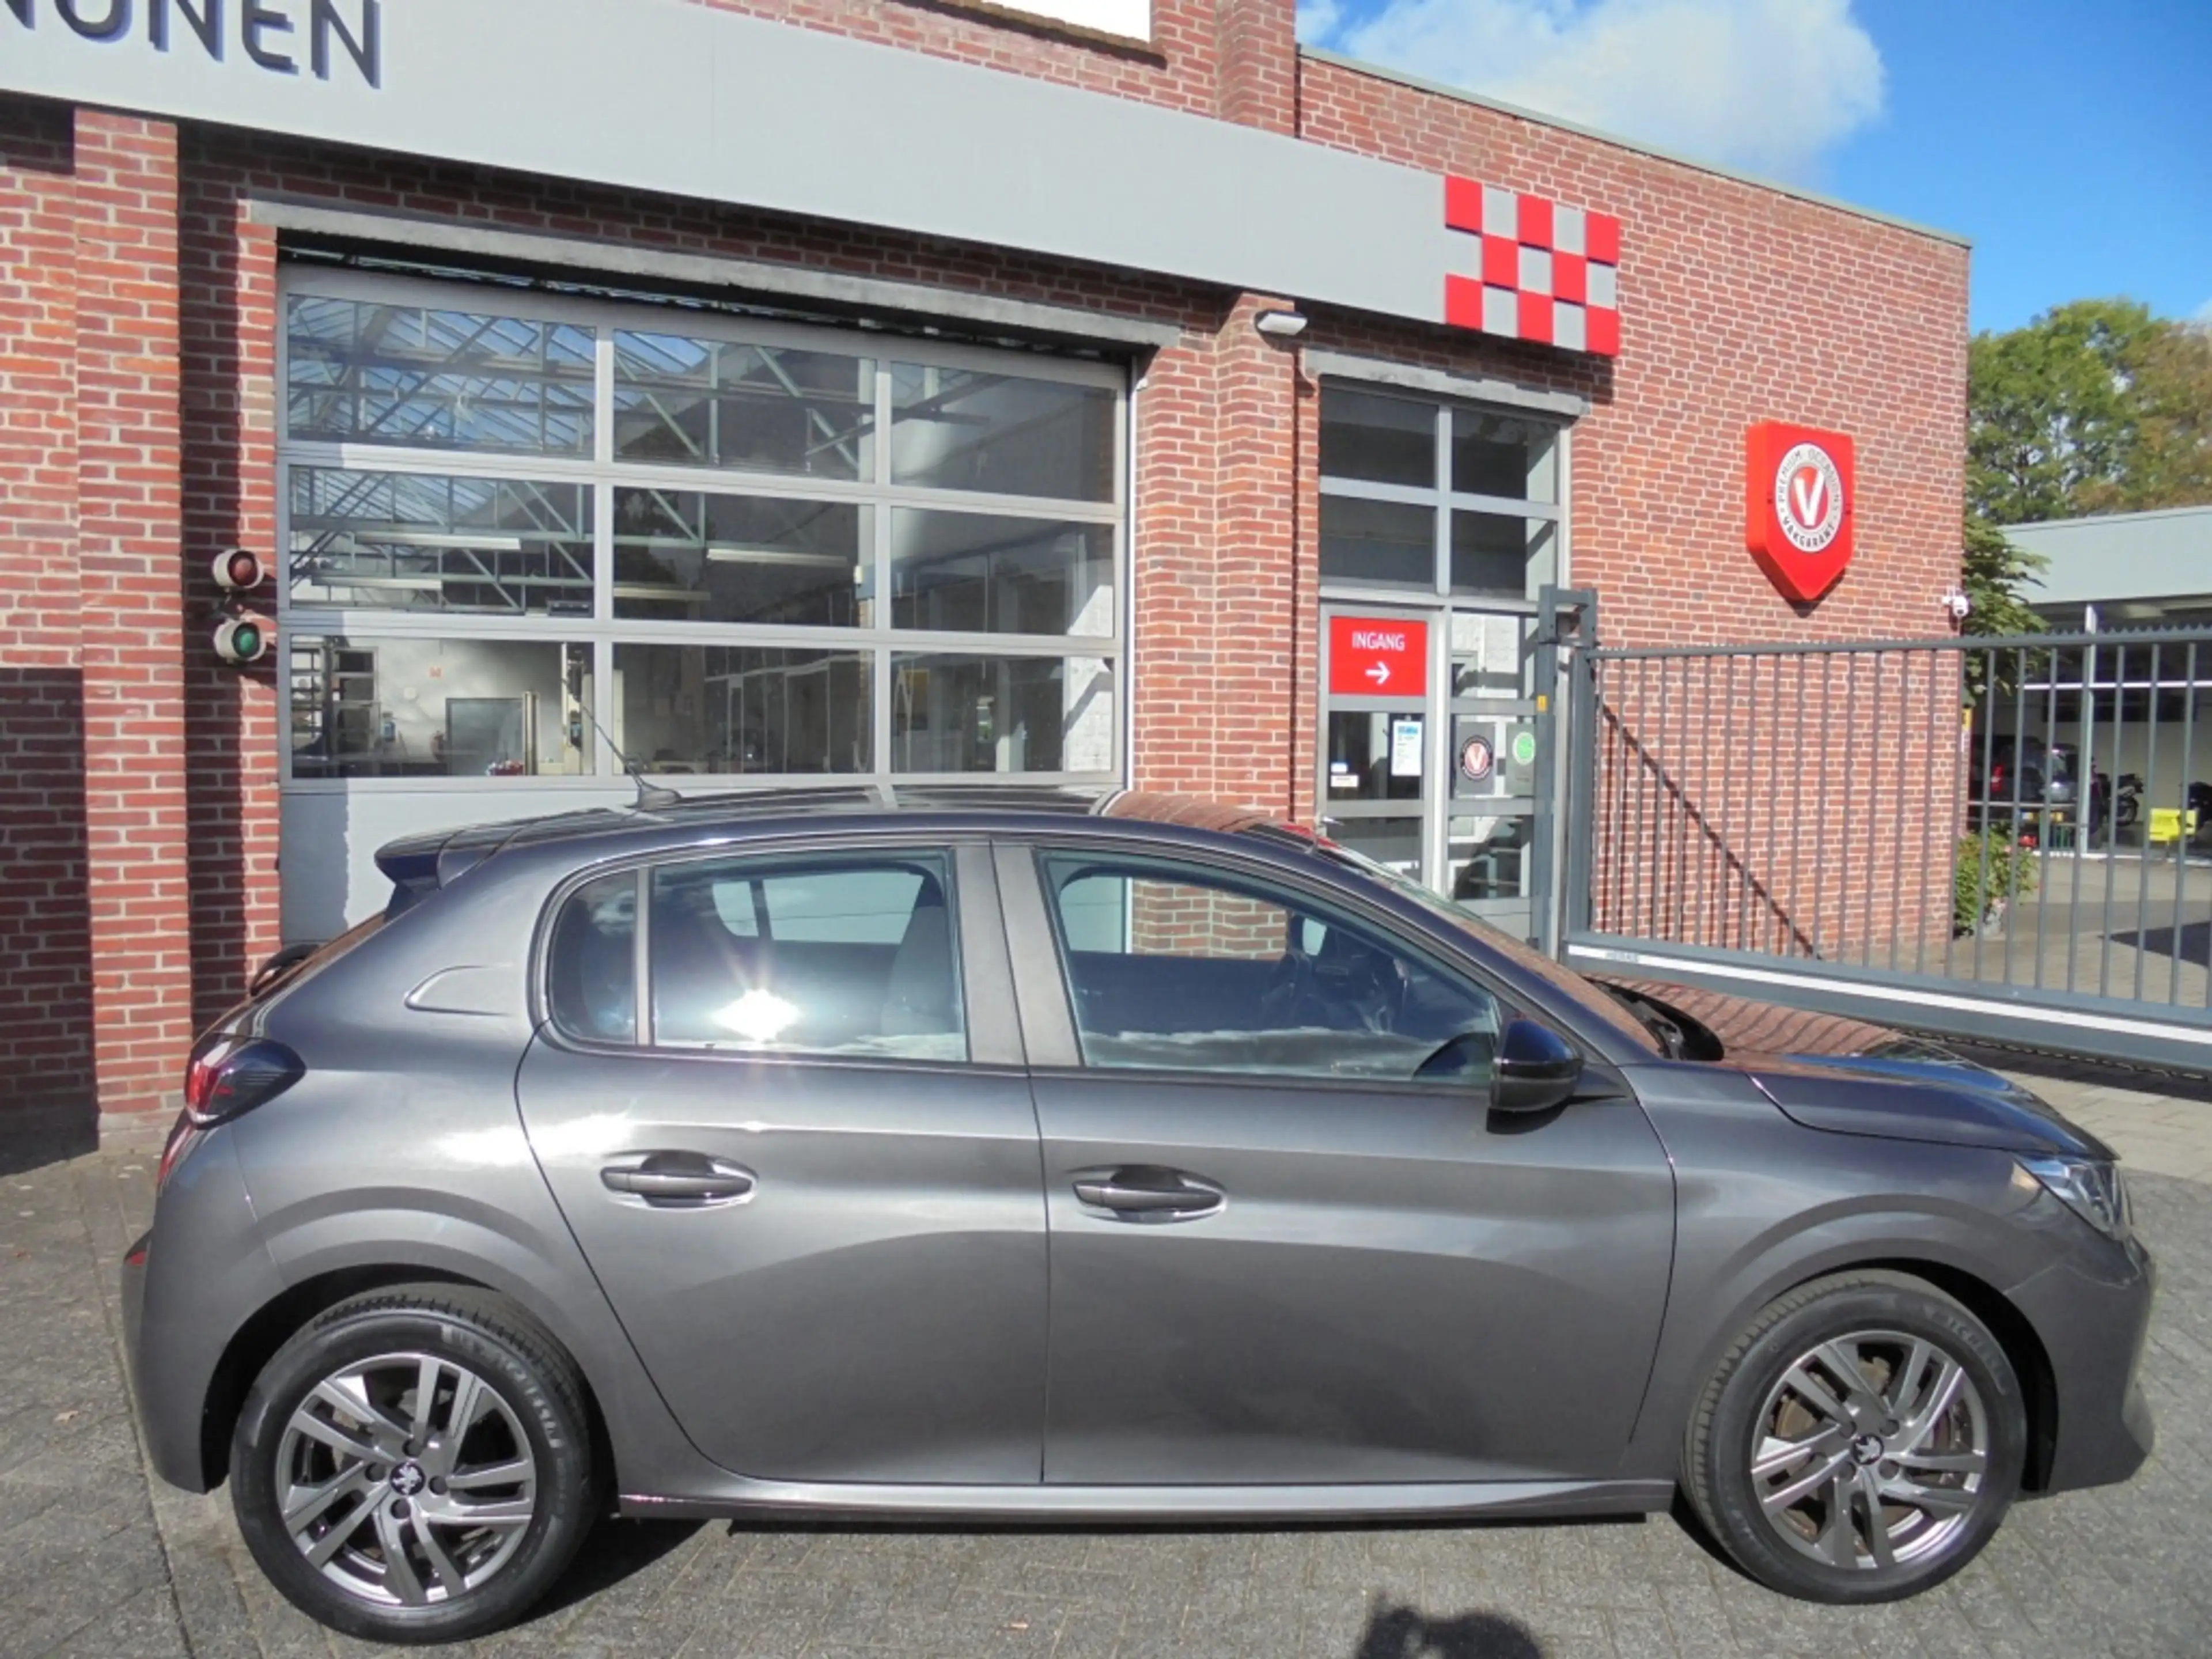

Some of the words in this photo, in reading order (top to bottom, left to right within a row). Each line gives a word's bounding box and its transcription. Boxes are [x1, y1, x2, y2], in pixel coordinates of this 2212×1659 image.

[3, 0, 380, 89] NEN
[1794, 470, 1825, 525] V
[1352, 631, 1406, 652] INGANG
